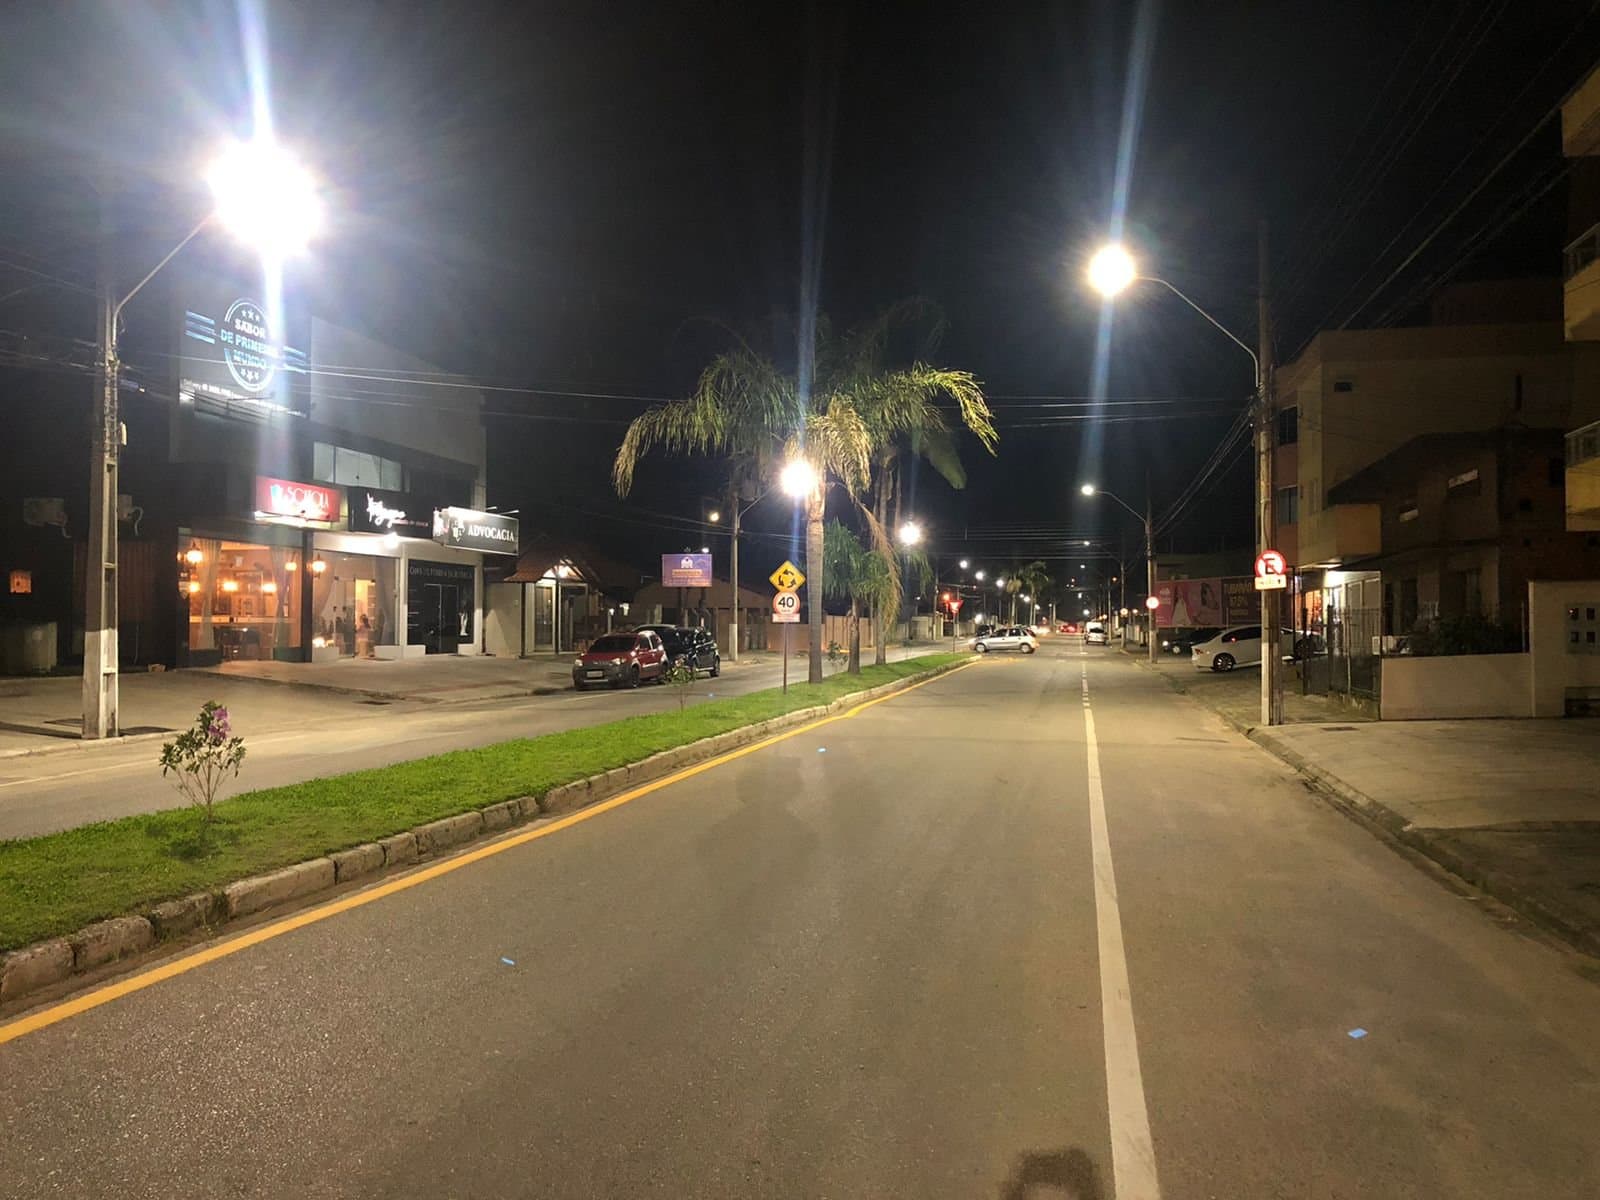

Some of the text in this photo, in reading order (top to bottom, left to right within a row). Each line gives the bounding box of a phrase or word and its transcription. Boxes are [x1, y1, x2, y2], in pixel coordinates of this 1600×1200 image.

[234, 318, 266, 339] SABOR
[220, 328, 281, 359] DE PRIME
[233, 349, 267, 369] MUNDO
[468, 525, 515, 542] ADVOCACIA
[778, 596, 795, 609] 40
